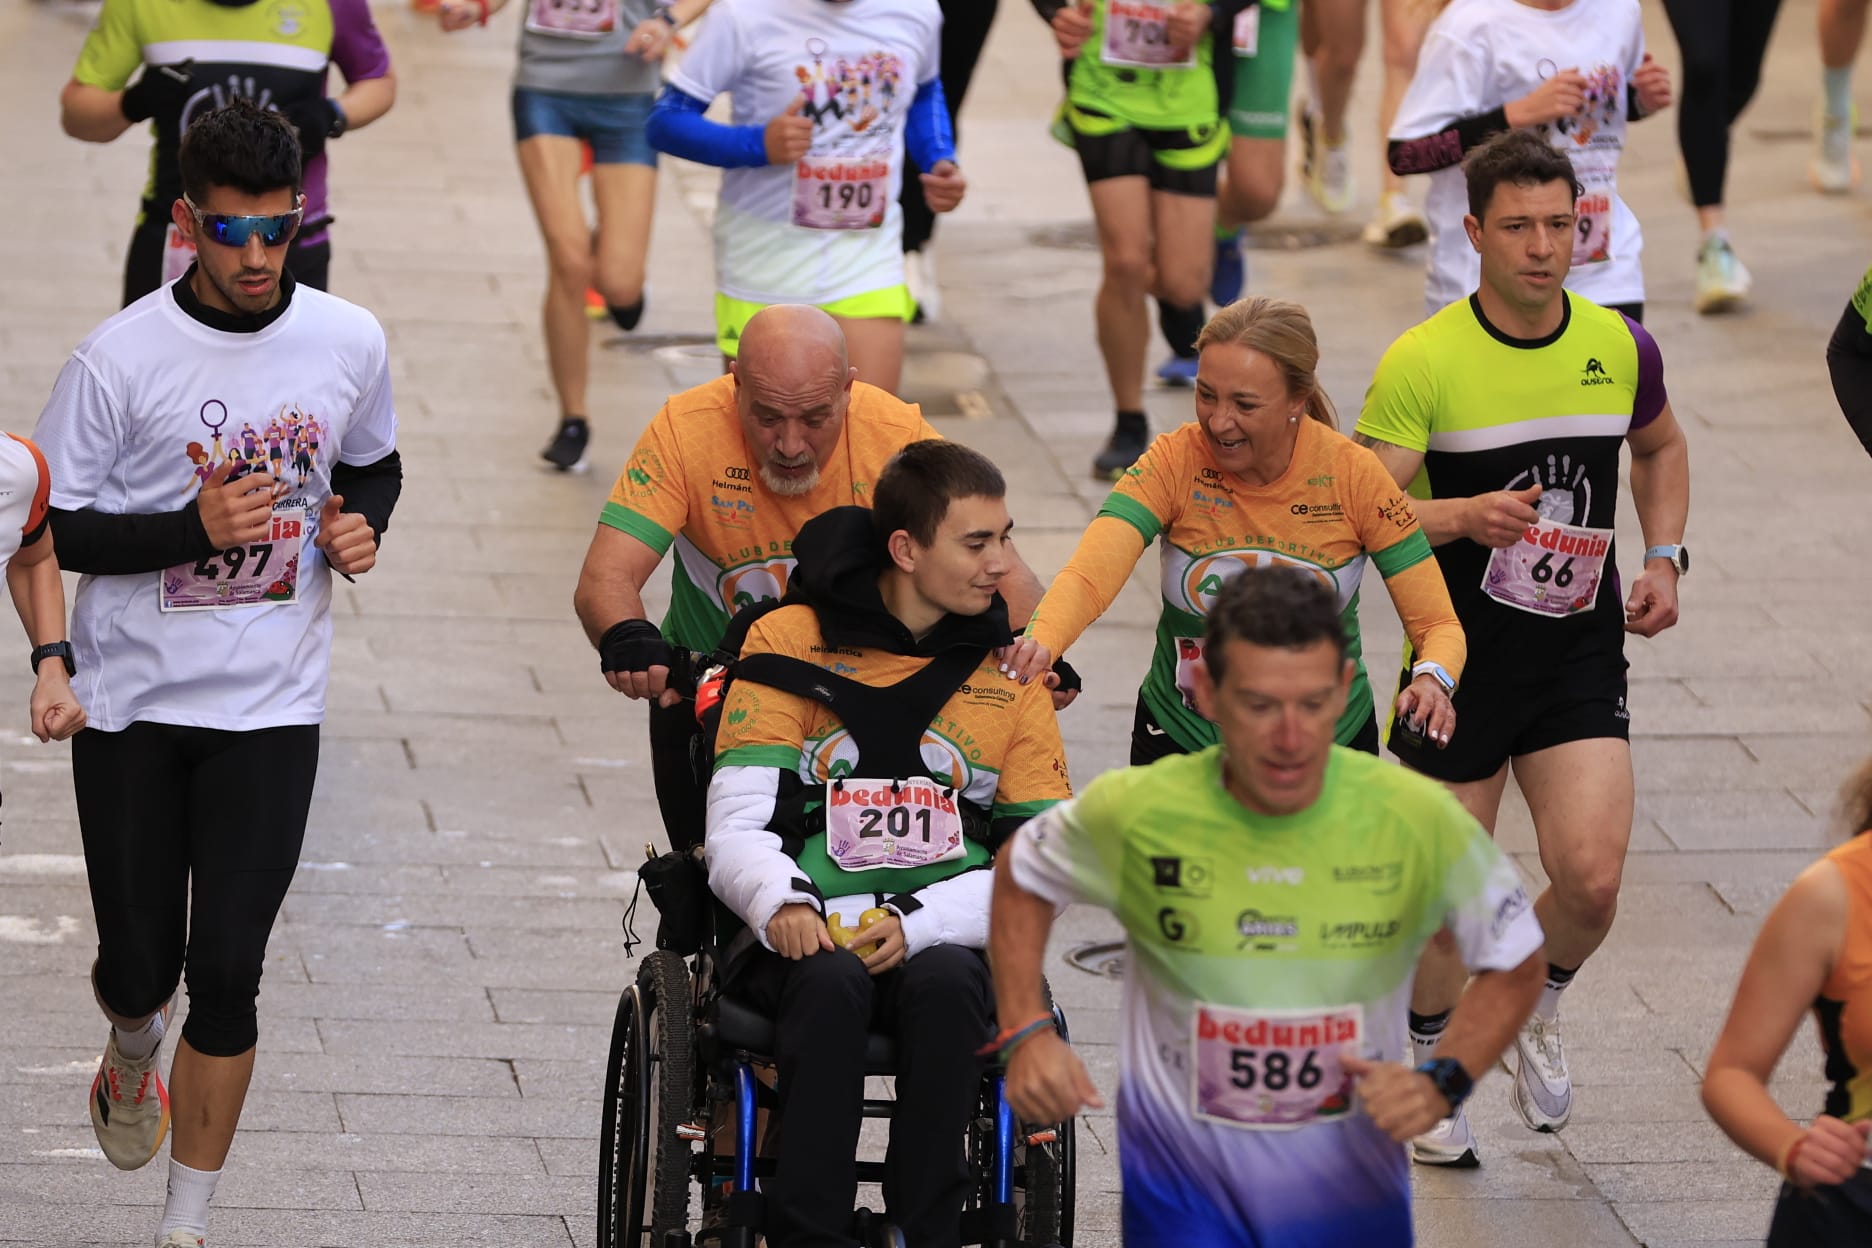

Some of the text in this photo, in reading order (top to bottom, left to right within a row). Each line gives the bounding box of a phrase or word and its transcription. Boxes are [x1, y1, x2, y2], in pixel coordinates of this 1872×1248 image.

[1124, 18, 1170, 45] 70
[819, 182, 872, 209] 190
[1574, 194, 1609, 216] nia
[712, 480, 752, 493] Helmánt
[272, 498, 308, 511] CARRERA
[769, 541, 793, 552] DE
[1193, 535, 1336, 566] CLUB DEPORTIVO
[1522, 526, 1608, 557] edunia
[194, 543, 273, 580] 497
[1531, 552, 1576, 588] 66
[972, 687, 1016, 701] consulting
[831, 785, 957, 816] bedunia
[859, 806, 931, 843] 201
[1198, 1008, 1356, 1048] bedunia
[1229, 1049, 1323, 1090] 586
